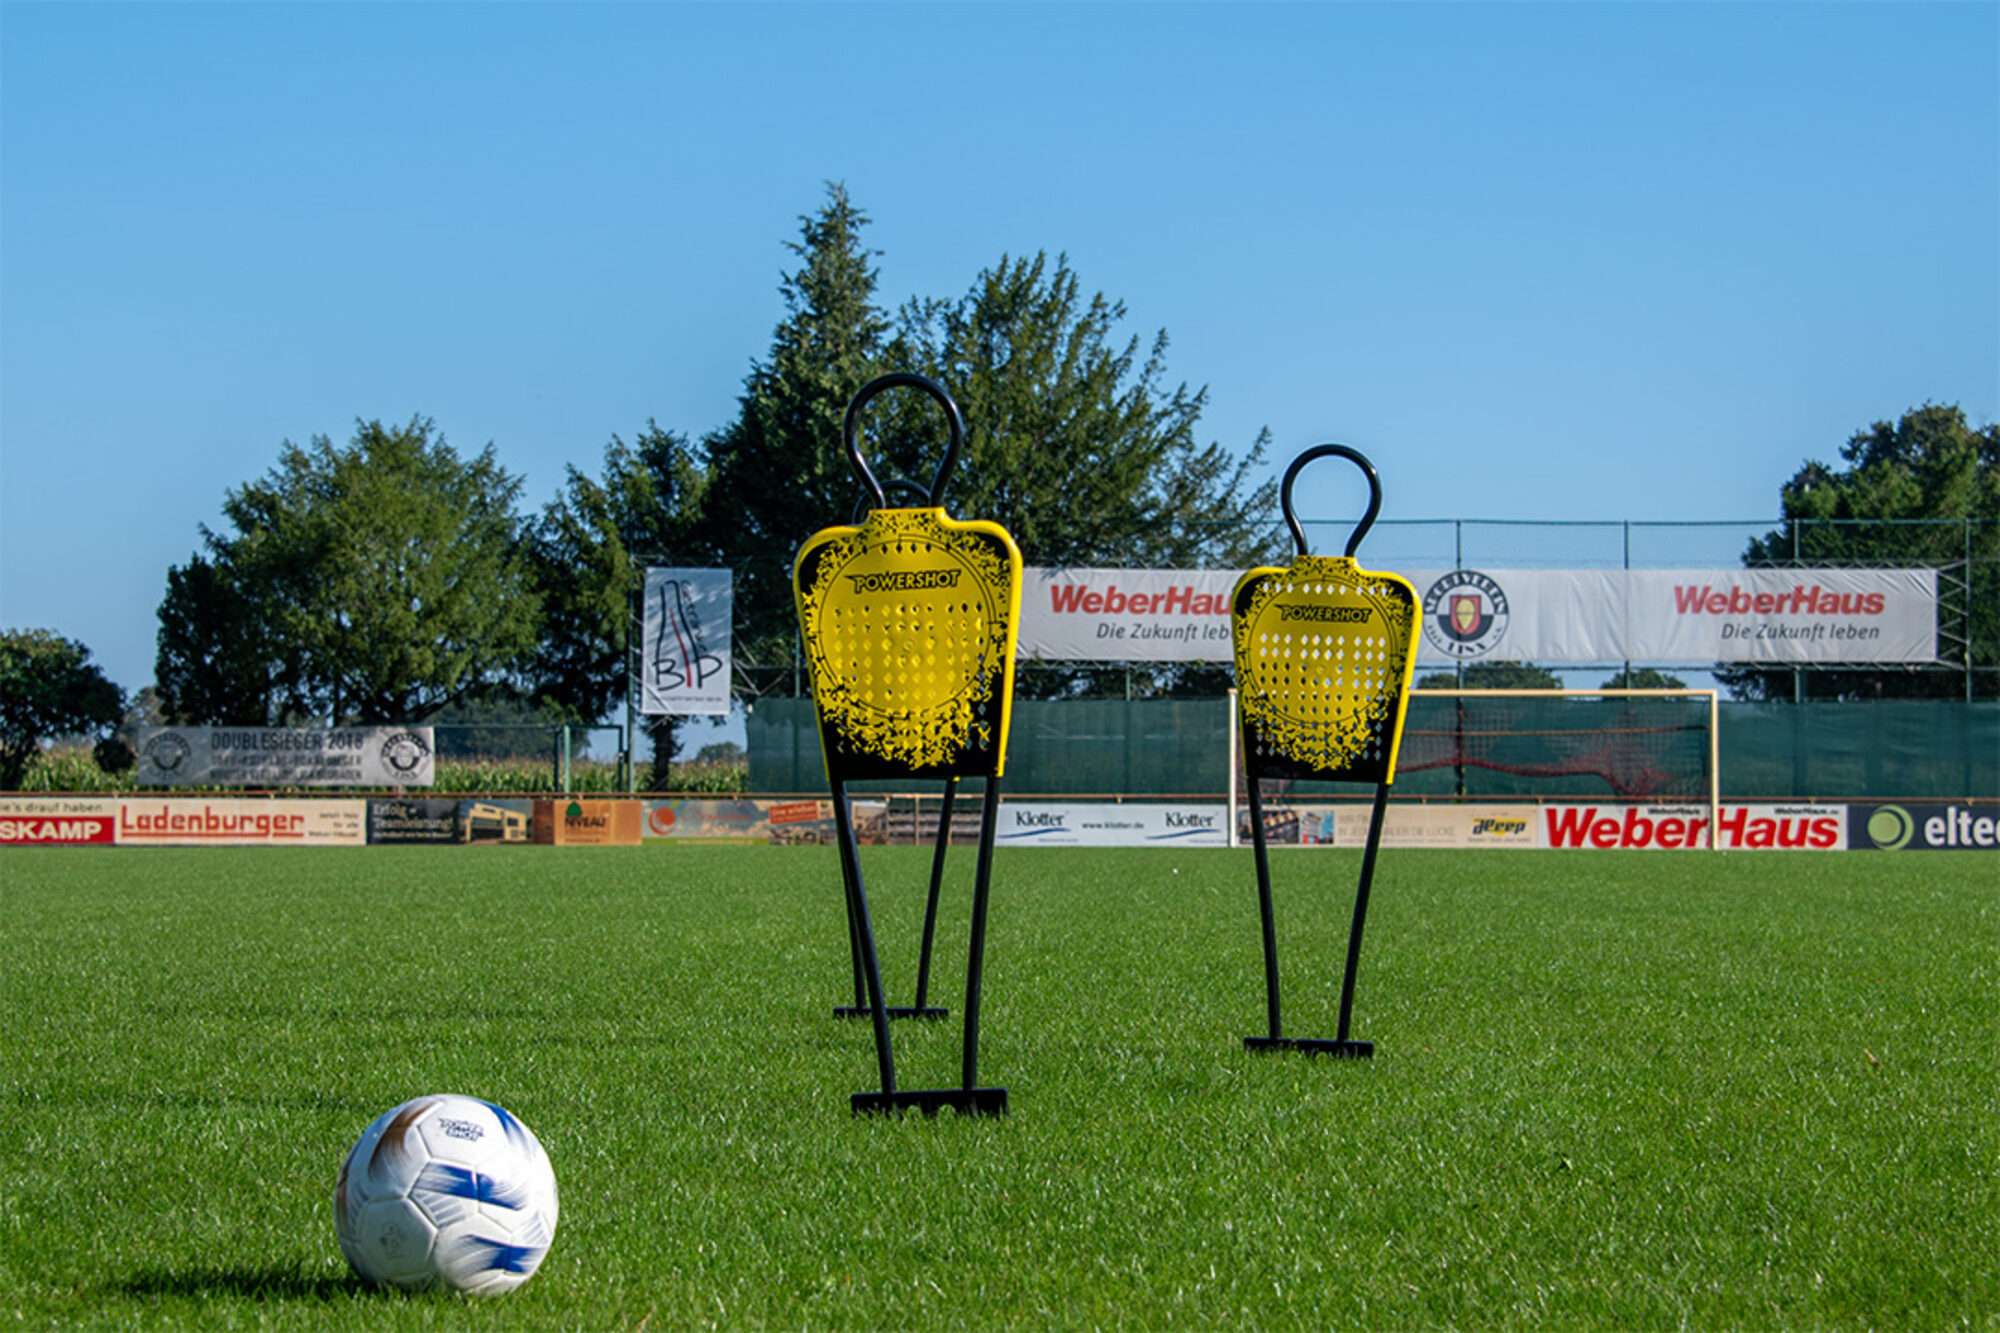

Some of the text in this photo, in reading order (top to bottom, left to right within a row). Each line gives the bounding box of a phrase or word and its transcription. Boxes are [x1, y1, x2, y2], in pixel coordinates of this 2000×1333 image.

[843, 569, 961, 594] POWERSHOT
[1050, 585, 1233, 615] WeberHau
[1674, 585, 1884, 615] WeberHaus
[1275, 604, 1372, 623] POWERSHOT
[1096, 623, 1229, 643] Die Zukunft leb
[1721, 623, 1880, 643] Die Zukunft leben
[211, 732, 322, 750] DOUBLESIEGER
[25, 802, 60, 813] drauf
[63, 802, 102, 813] haben
[121, 805, 304, 837] Ladenburger
[1016, 810, 1065, 826] Klotter
[1165, 811, 1214, 827] Klotter
[1545, 807, 1839, 849] WeberHaus
[1924, 806, 2000, 846] elte
[0, 821, 102, 840] SKAMP
